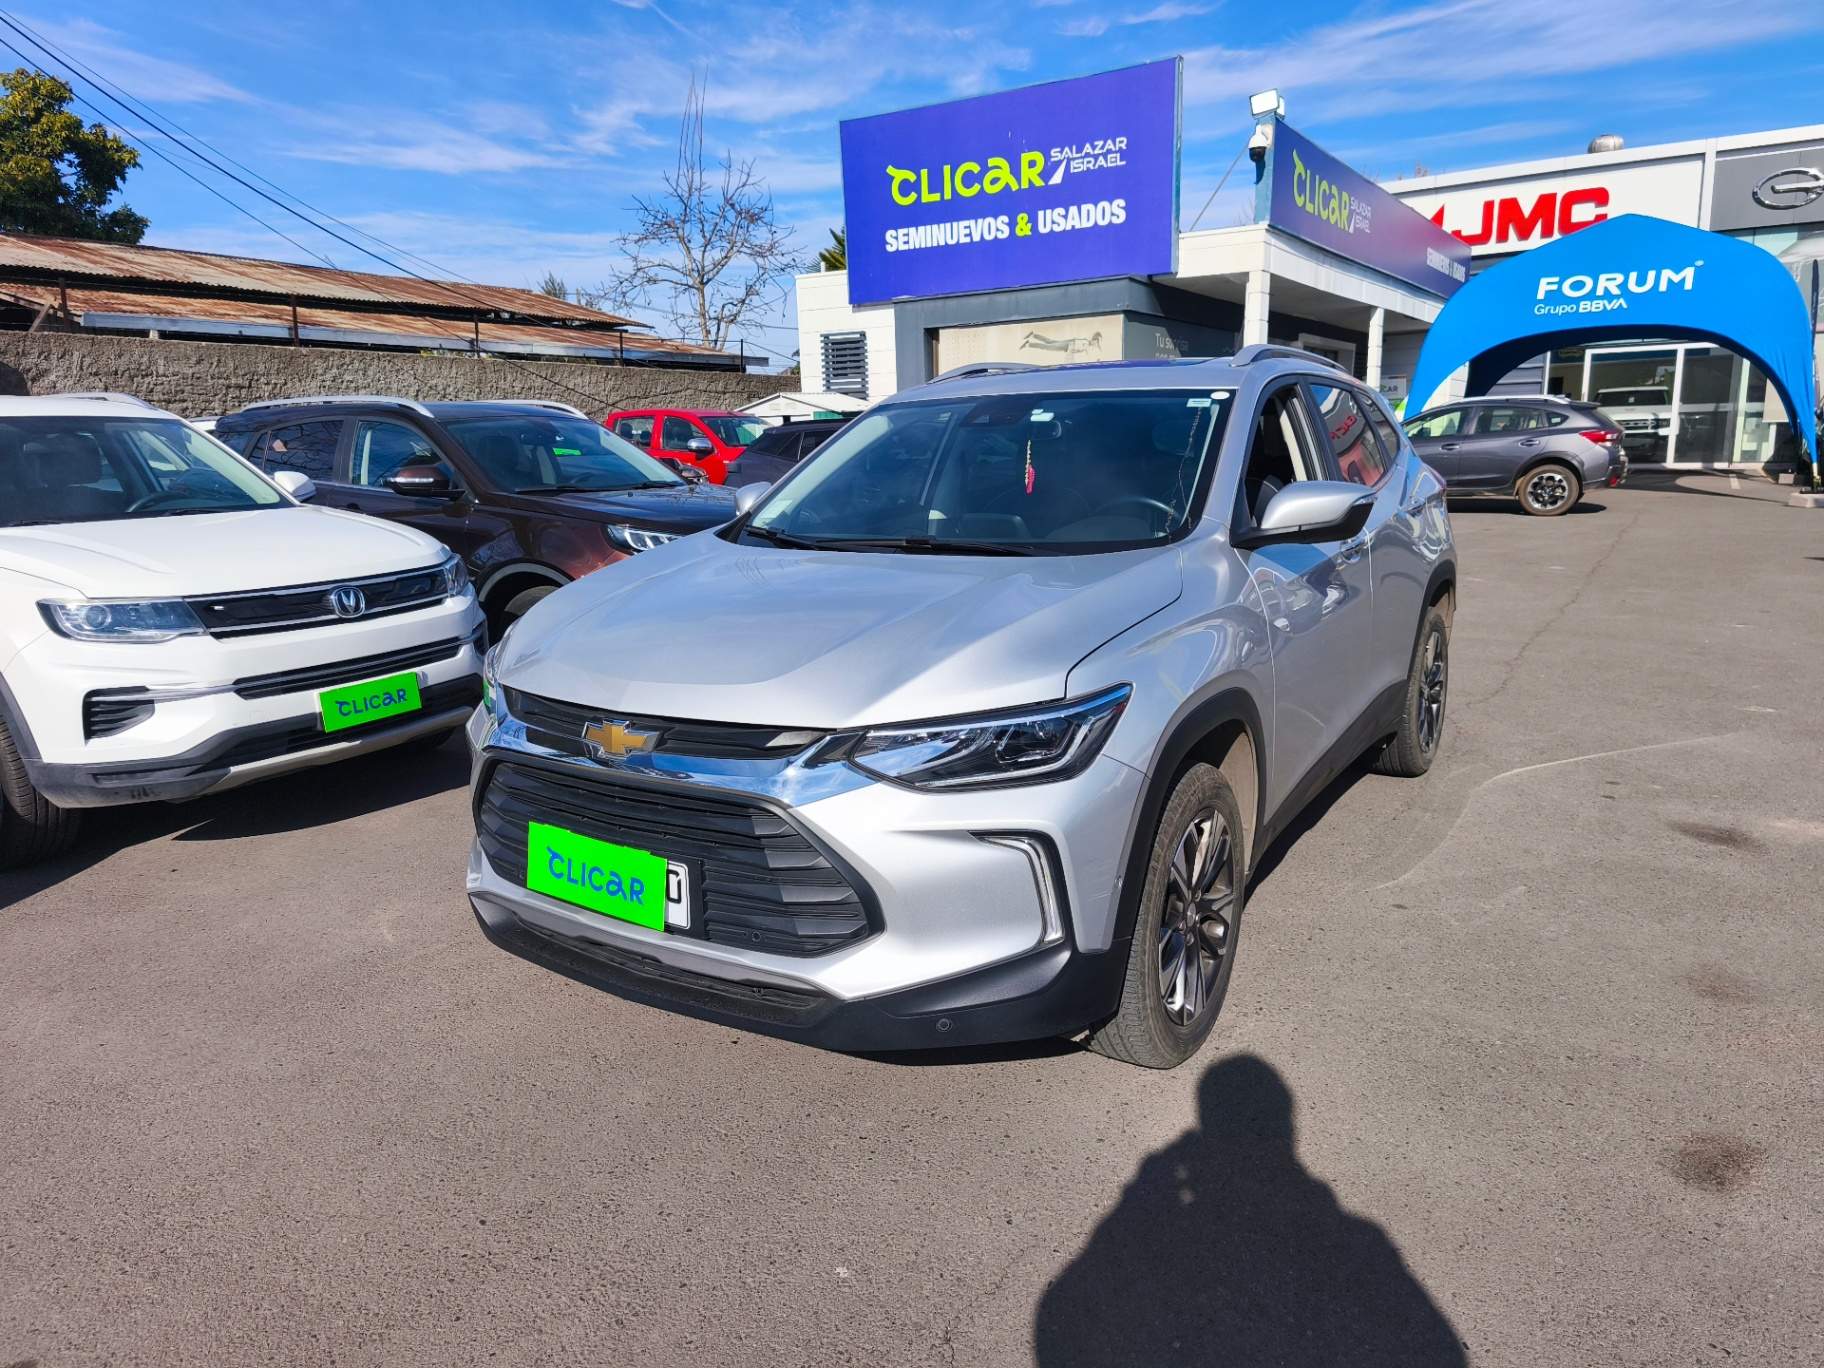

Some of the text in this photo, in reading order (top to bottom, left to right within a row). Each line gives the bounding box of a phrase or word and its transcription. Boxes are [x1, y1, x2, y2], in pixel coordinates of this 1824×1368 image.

[1049, 137, 1128, 163] SALAZAR
[1070, 153, 1127, 173] ISRAEL
[885, 199, 1127, 253] SEMINUEVOS & USADOS
[1450, 186, 1611, 246] JMC
[1536, 266, 1695, 300] FORUM
[1534, 297, 1629, 316] Grupo BBVA
